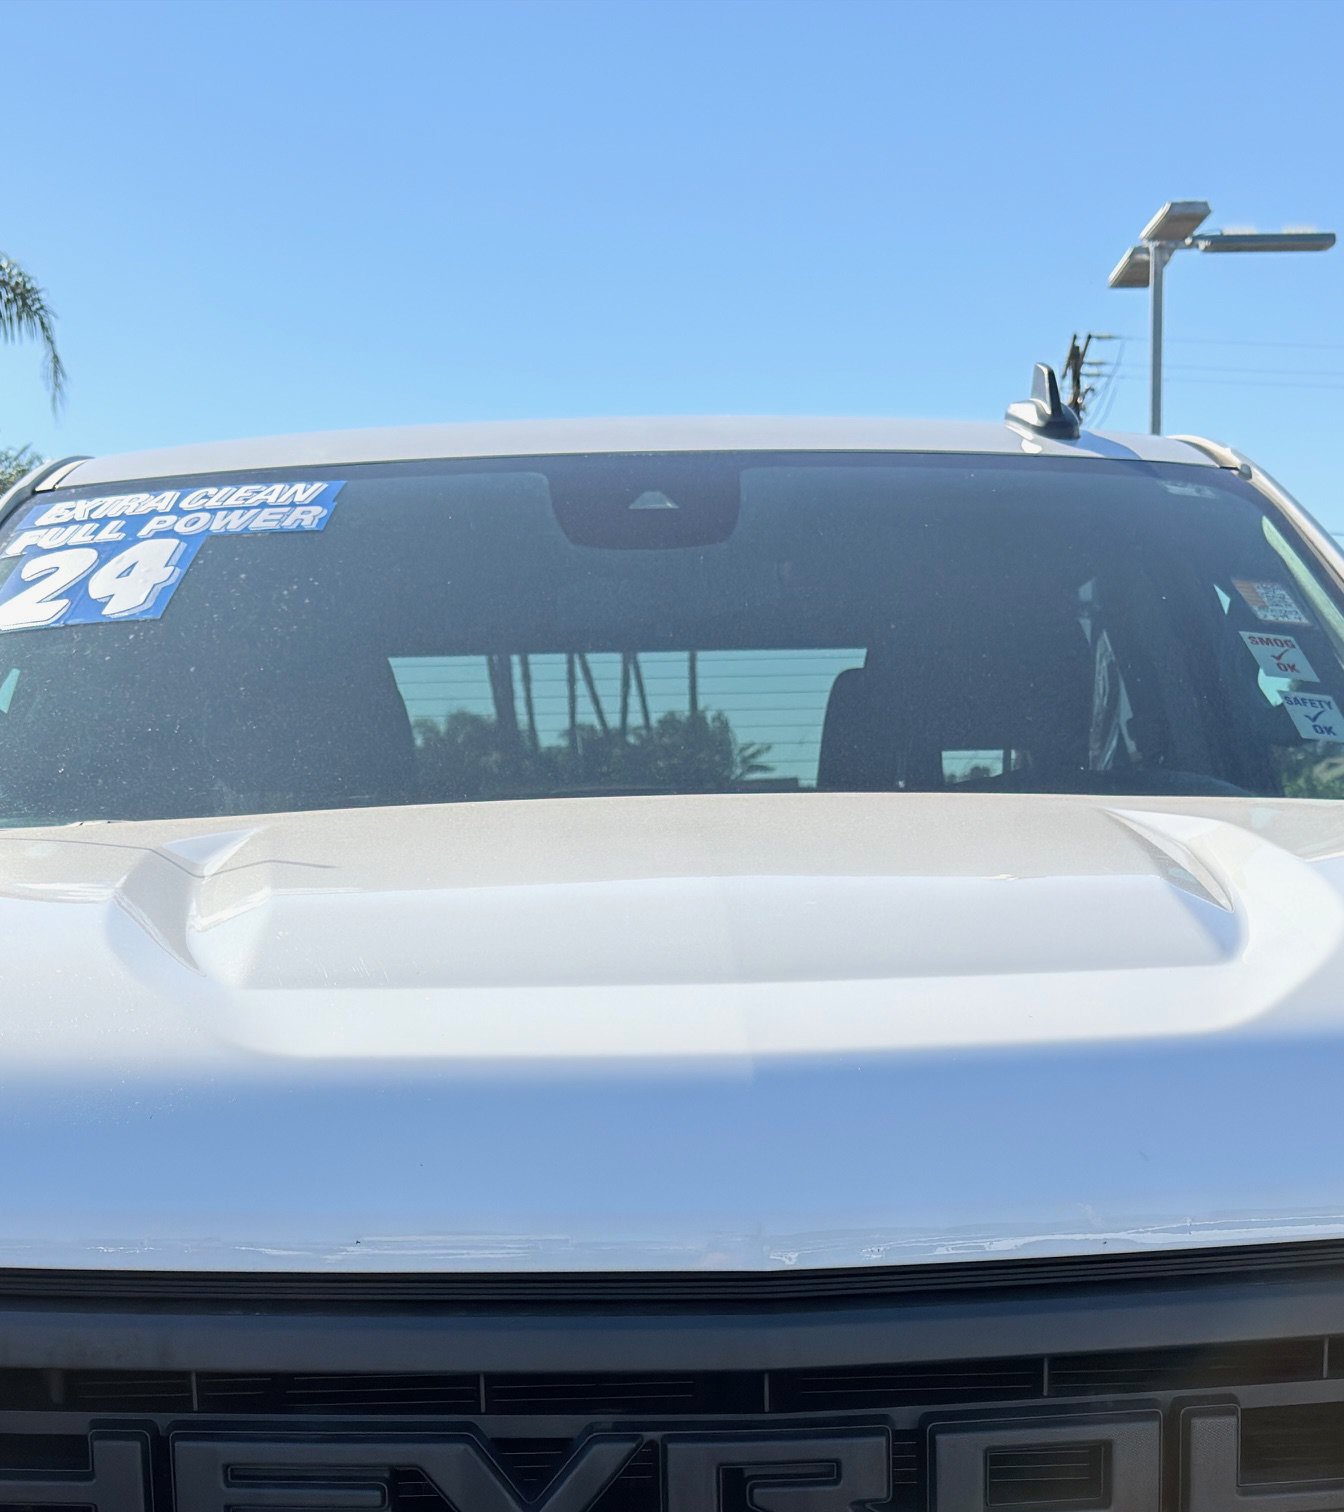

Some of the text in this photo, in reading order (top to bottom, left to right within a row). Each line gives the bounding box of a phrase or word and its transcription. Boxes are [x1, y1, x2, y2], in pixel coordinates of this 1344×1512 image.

[34, 482, 328, 526] EXTRA CLEAN
[0, 505, 328, 559] FULL POWER
[1248, 636, 1296, 650] SMOG
[1277, 662, 1301, 674] OK
[1284, 696, 1334, 711] SAFETY
[1312, 724, 1337, 736] OK
